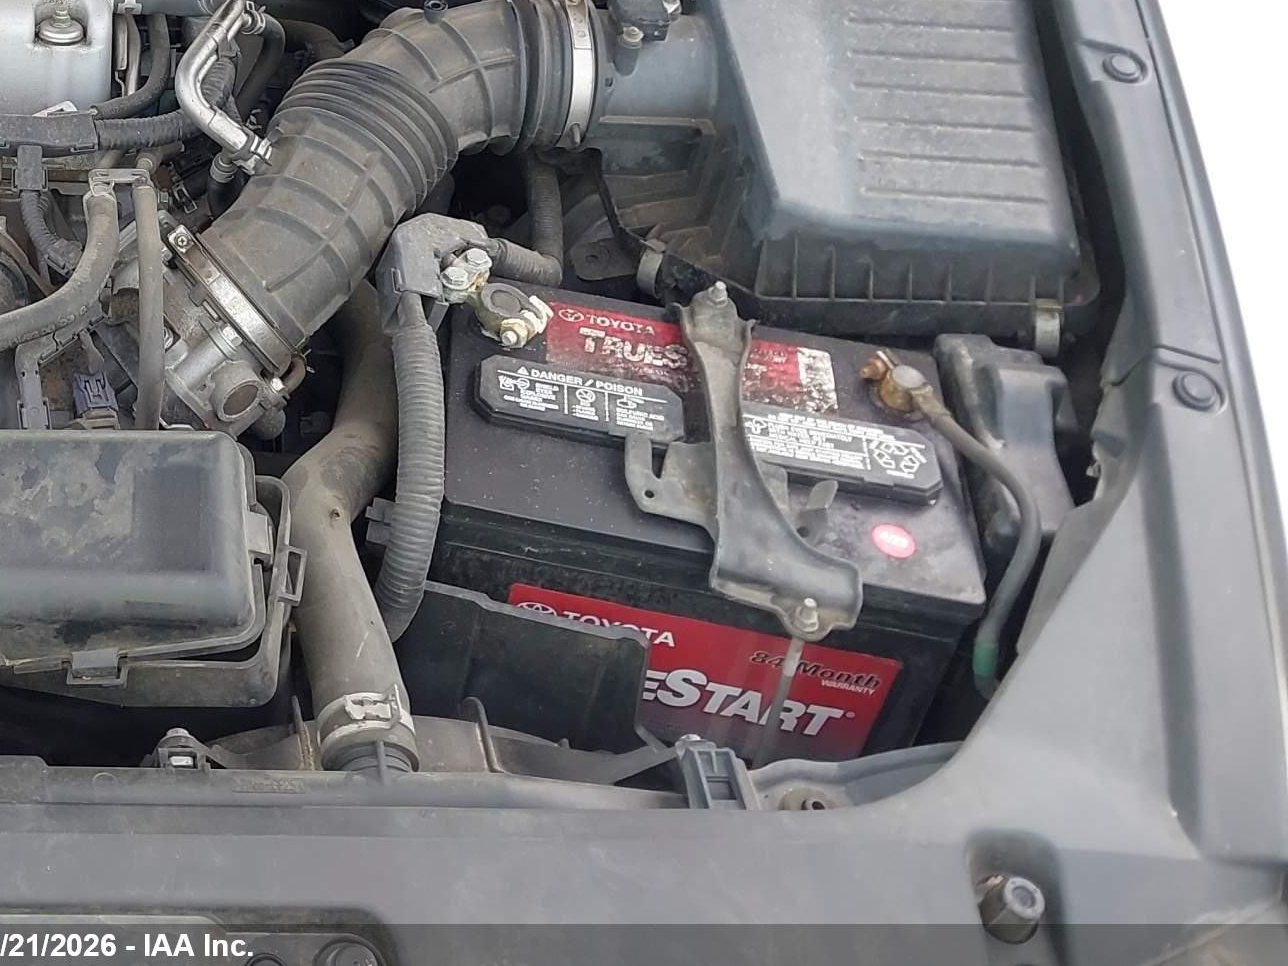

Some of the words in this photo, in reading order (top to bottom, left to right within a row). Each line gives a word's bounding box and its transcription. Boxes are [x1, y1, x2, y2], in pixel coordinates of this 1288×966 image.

[586, 314, 655, 335] TOYOTA
[531, 369, 582, 386] DANGER
[596, 381, 643, 396] POISON
[562, 610, 675, 647] TOTA
[750, 650, 786, 669] 84
[796, 662, 882, 689] Month
[821, 679, 877, 696] WARRANTY
